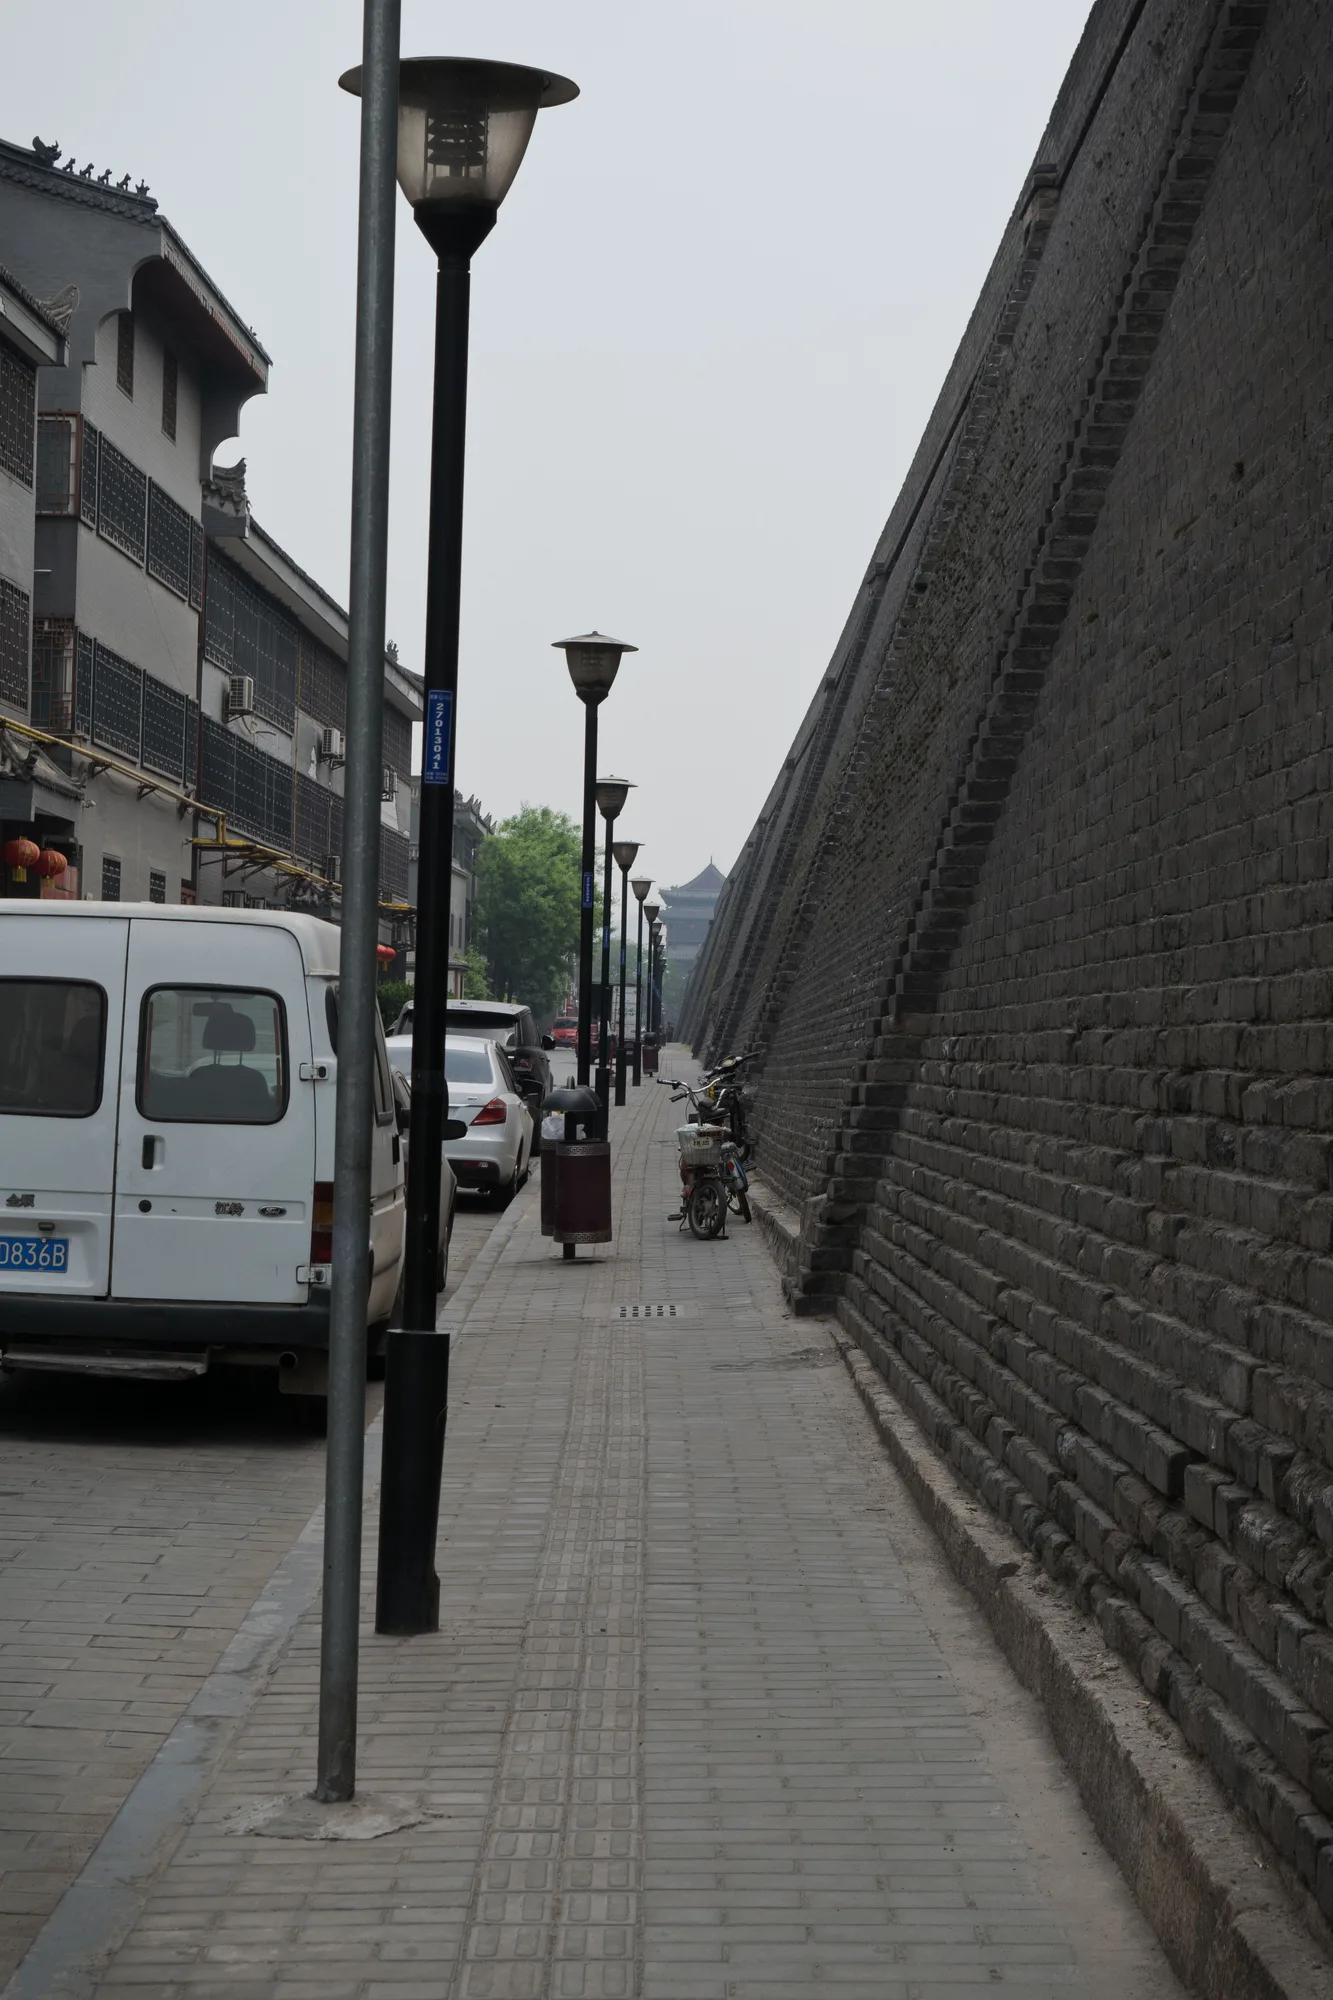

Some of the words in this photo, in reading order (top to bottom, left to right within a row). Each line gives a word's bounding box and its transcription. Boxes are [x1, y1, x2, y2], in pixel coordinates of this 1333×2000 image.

[432, 703, 444, 769] 27013041
[6, 1193, 35, 1208] 全顺
[215, 1202, 244, 1217] 江铃
